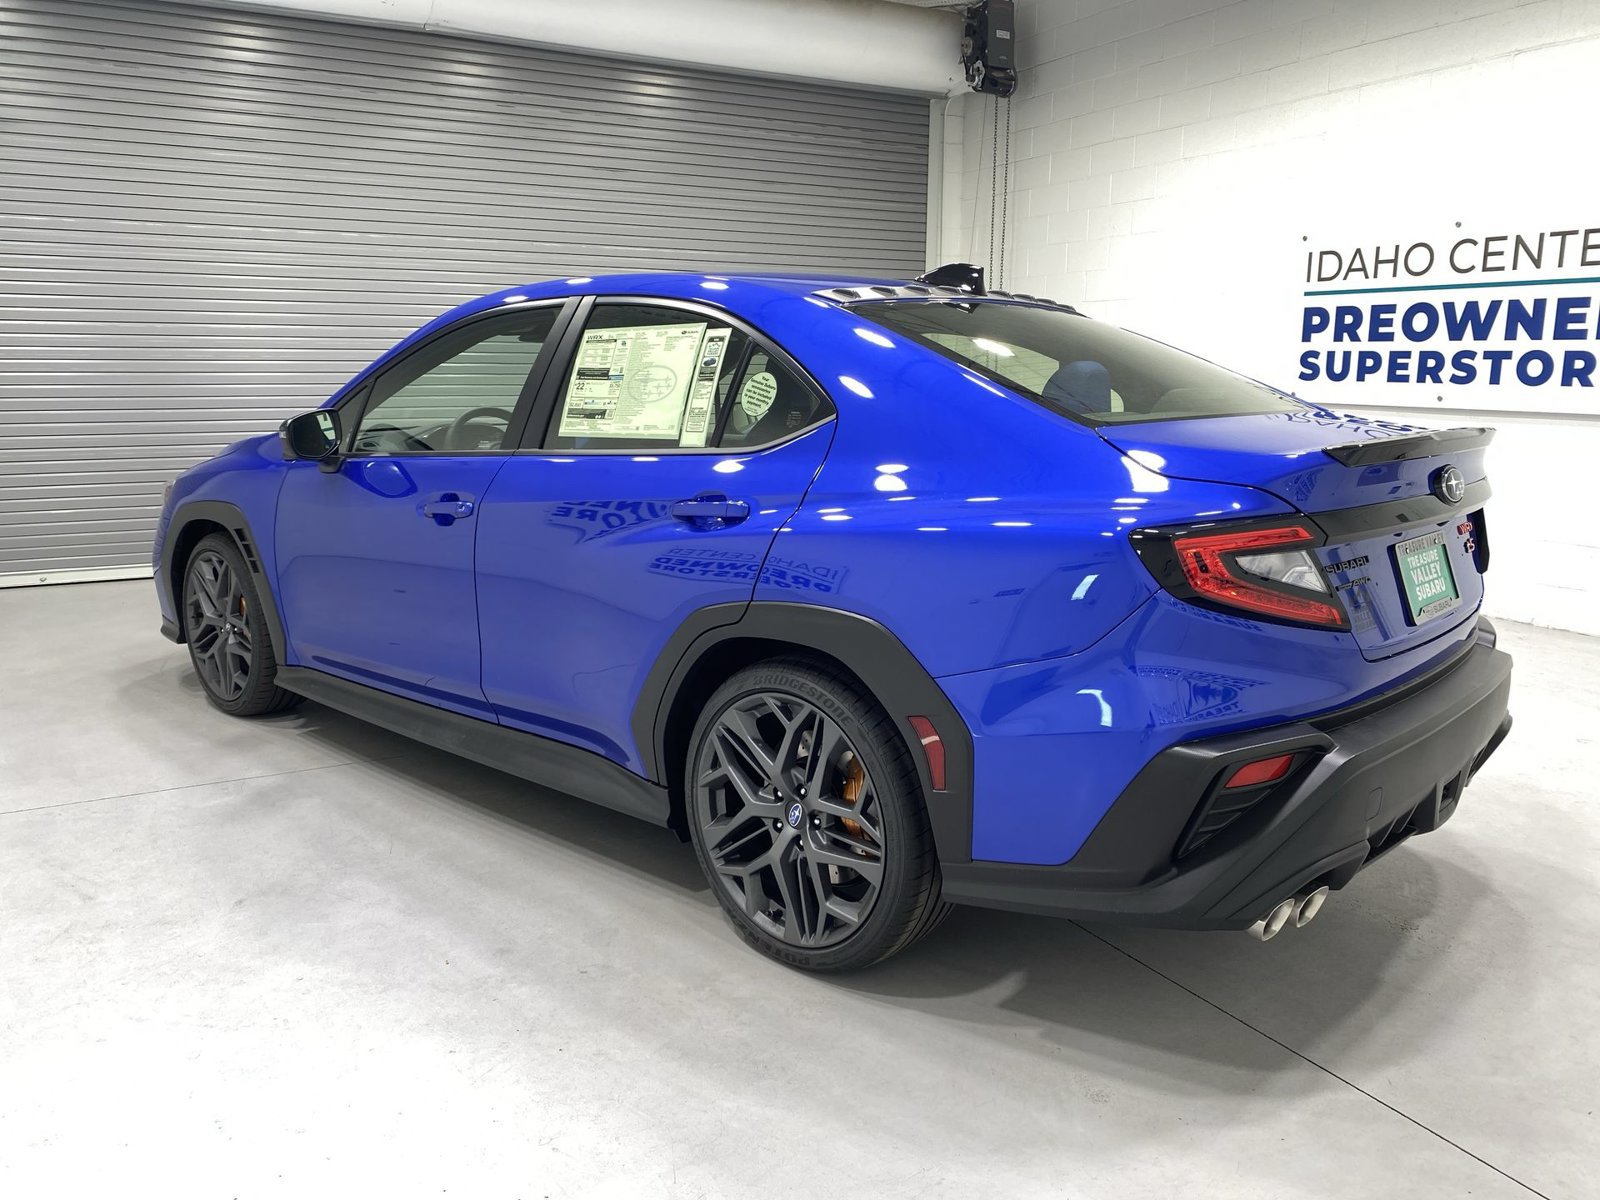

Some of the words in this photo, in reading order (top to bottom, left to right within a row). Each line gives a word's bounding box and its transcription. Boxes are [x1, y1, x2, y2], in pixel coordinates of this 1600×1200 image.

[1306, 242, 1435, 283] IDAHO
[1301, 296, 1600, 343] PREOWNE
[1407, 549, 1439, 569] TREASURE
[1410, 561, 1442, 585] VALLEY
[1415, 577, 1446, 601] SUBARU
[752, 674, 856, 728] BRIDGESTONE
